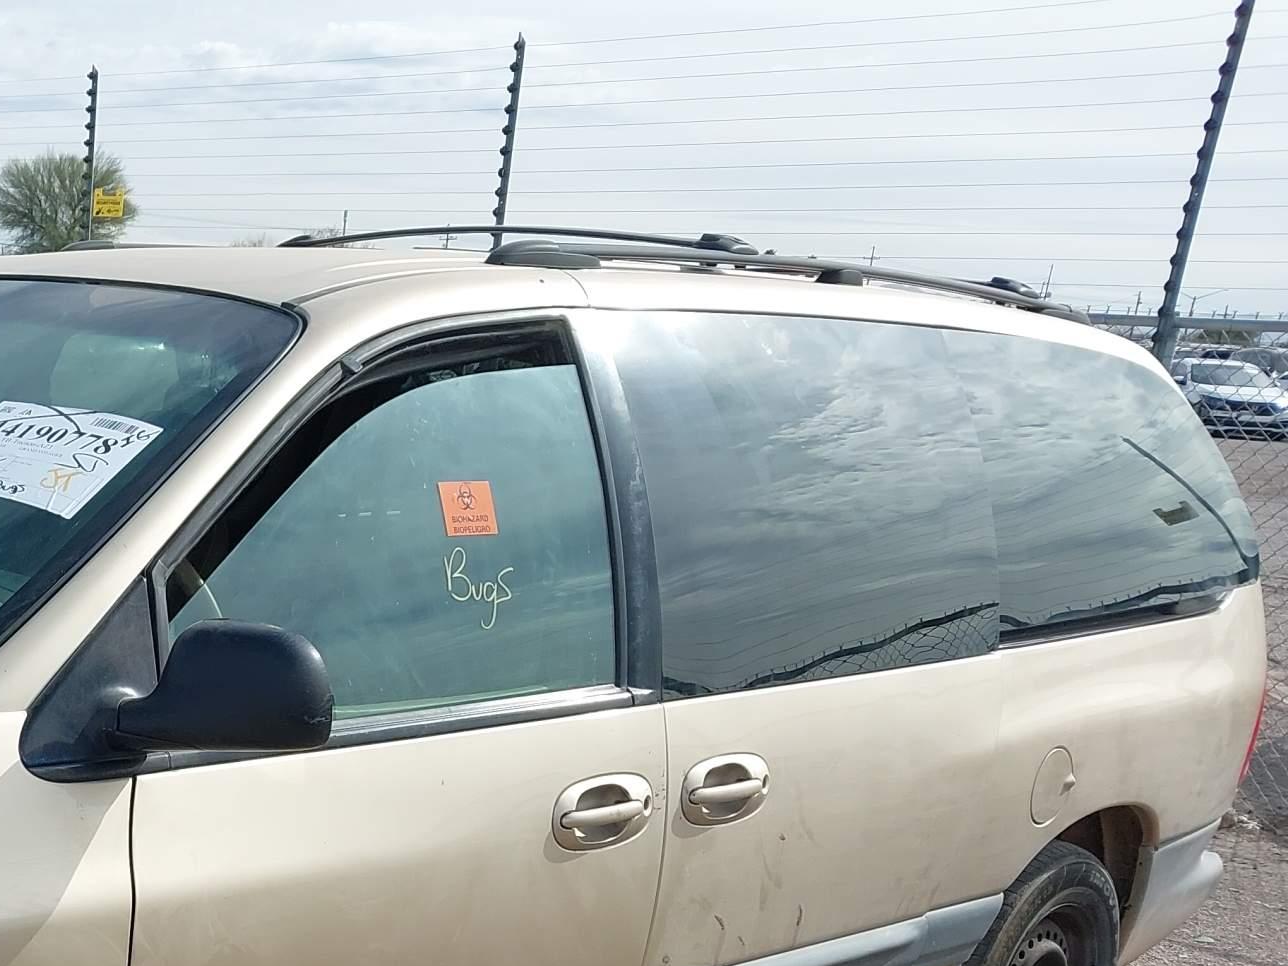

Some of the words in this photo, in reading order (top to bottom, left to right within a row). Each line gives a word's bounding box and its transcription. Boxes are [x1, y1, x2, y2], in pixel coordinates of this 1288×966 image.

[452, 515, 489, 523] BIOHAZARD
[453, 525, 491, 534] BIOPELIGRO
[444, 547, 514, 629] Bugs
